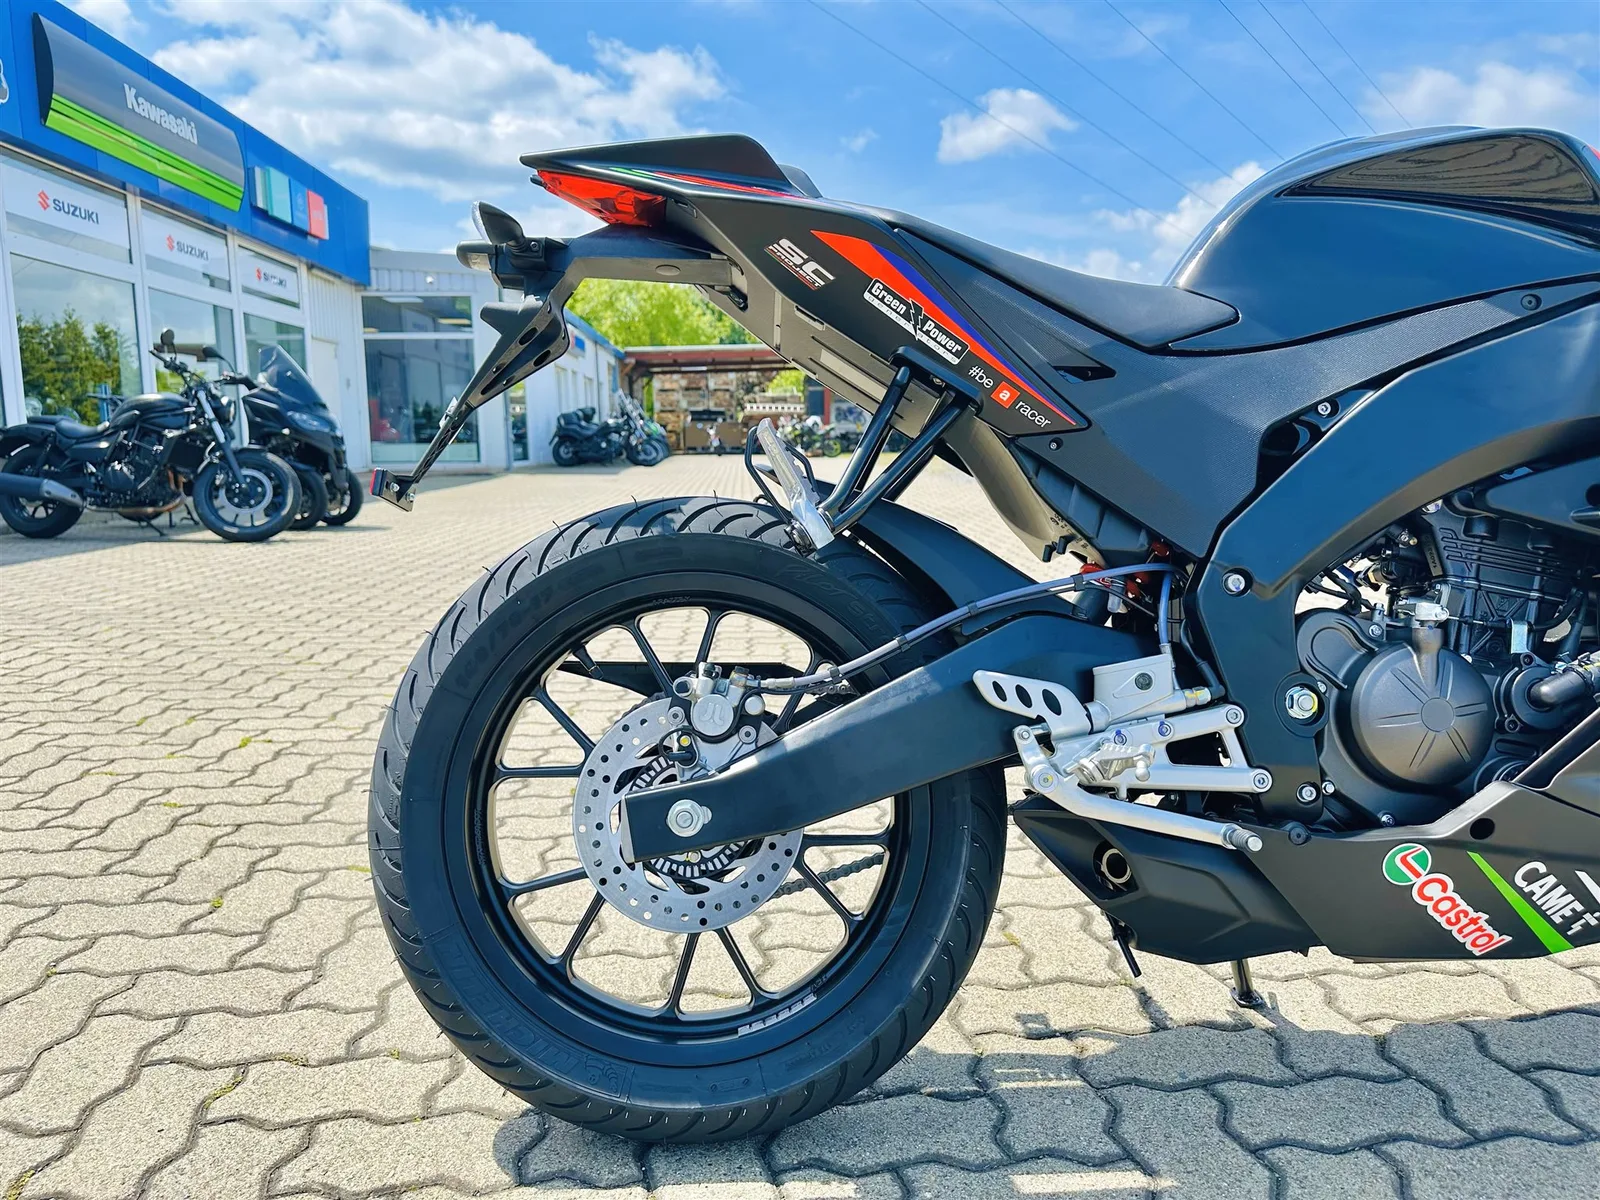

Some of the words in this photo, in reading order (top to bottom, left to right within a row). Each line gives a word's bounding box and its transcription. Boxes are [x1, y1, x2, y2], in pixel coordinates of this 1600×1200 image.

[124, 83, 197, 145] Kawasaki
[52, 198, 100, 225] SUZUKI
[176, 240, 209, 261] SUZUKI
[871, 282, 907, 315] Green
[922, 320, 962, 353] Power
[968, 365, 994, 389] #be
[999, 389, 1011, 401] a
[1015, 401, 1052, 428] racer
[1416, 876, 1507, 954] Castrol
